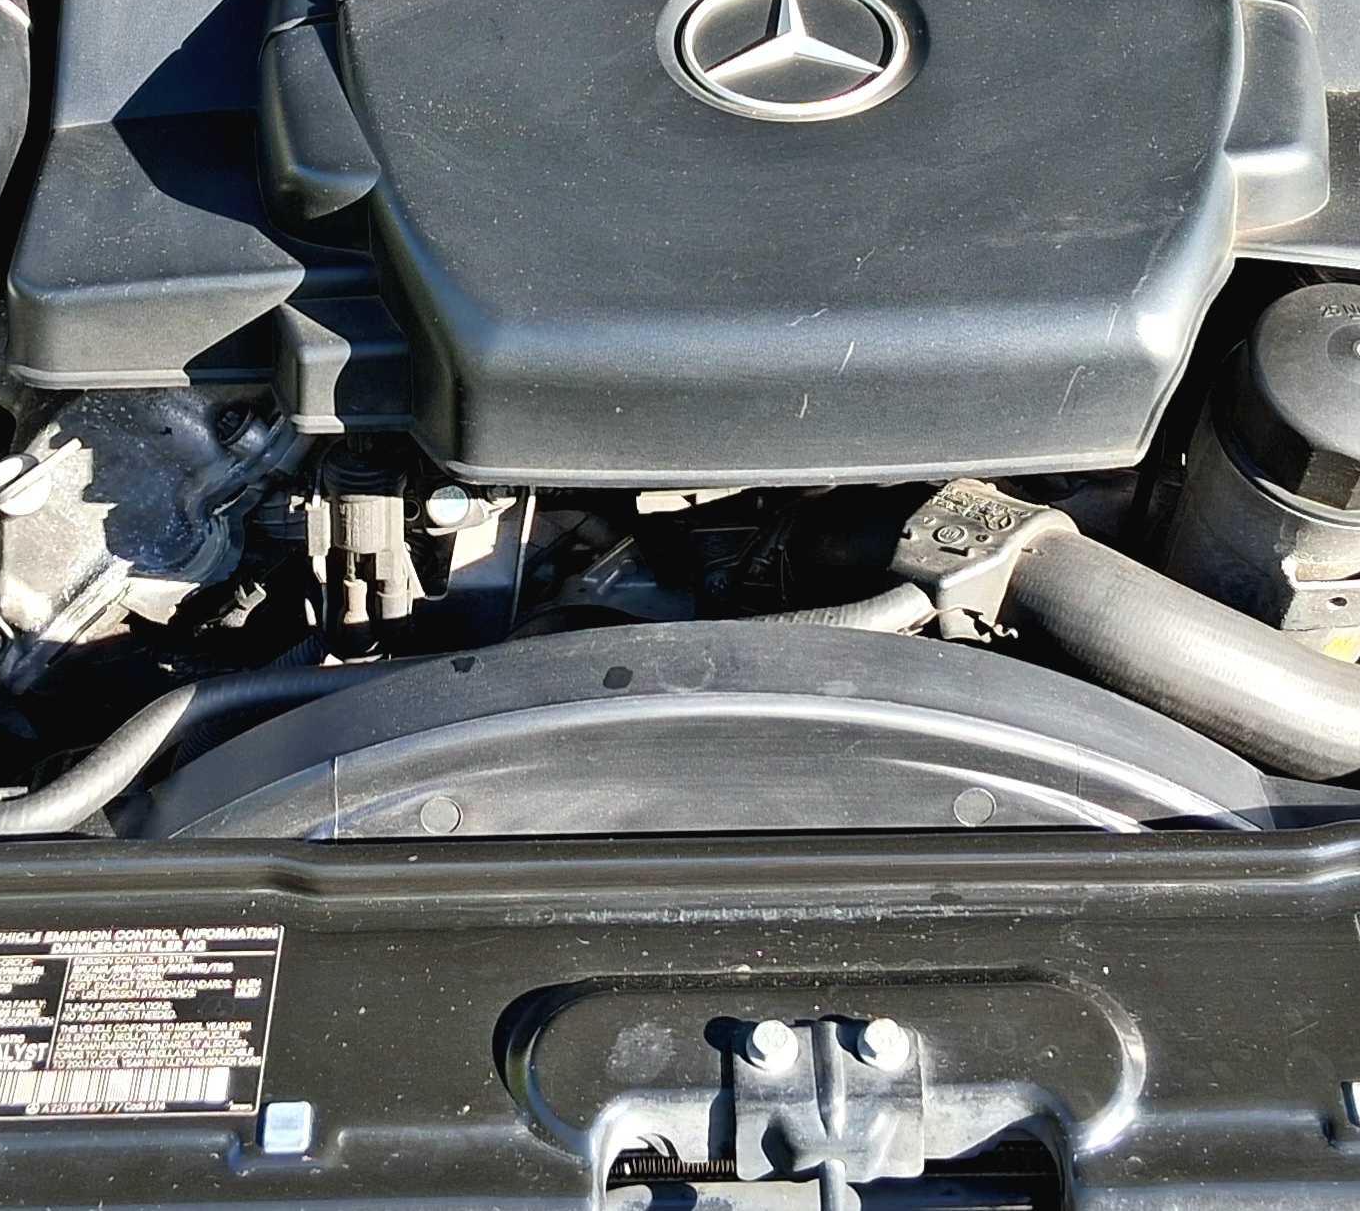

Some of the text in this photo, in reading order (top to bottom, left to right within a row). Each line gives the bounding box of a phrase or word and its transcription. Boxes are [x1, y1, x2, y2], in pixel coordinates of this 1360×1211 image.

[44, 930, 112, 942] EMISSION
[115, 929, 179, 941] CONTROL
[182, 927, 278, 940] INFORMATION
[51, 940, 206, 953] DAIMLERCHRYSLER AG
[73, 957, 114, 965] EMISSION
[94, 981, 134, 989] EXHAUST
[136, 981, 176, 989] EMISSION
[100, 989, 140, 997] EMISSION
[65, 1003, 102, 1011] TUNE-UP
[62, 1012, 76, 1020] NO
[78, 1011, 141, 1020] ADJUSTMENTS
[60, 1025, 78, 1033] THIS
[79, 1025, 113, 1033] VEHICLE
[114, 1024, 160, 1032] CONFORMS
[175, 1023, 204, 1031] MODEL
[229, 1022, 252, 1030] 2003
[76, 1033, 90, 1041] EPA
[114, 1032, 171, 1040] REGULATIONS
[191, 1031, 239, 1039] APPLICABLE
[56, 1042, 100, 1051] CANADIAN
[101, 1042, 138, 1050] EMISSION
[202, 1040, 225, 1048] ALSO
[54, 1048, 254, 1060] FORMS TO CALIFORNIA REGULATIONS APPLICABLE
[52, 1060, 65, 1068] TO
[90, 1059, 118, 1067] MODEL
[144, 1058, 164, 1066] NEW
[165, 1058, 186, 1066] ULEV
[187, 1057, 237, 1065] PASSENGER
[238, 1057, 261, 1065] CARS
[123, 1103, 146, 1111] Code
